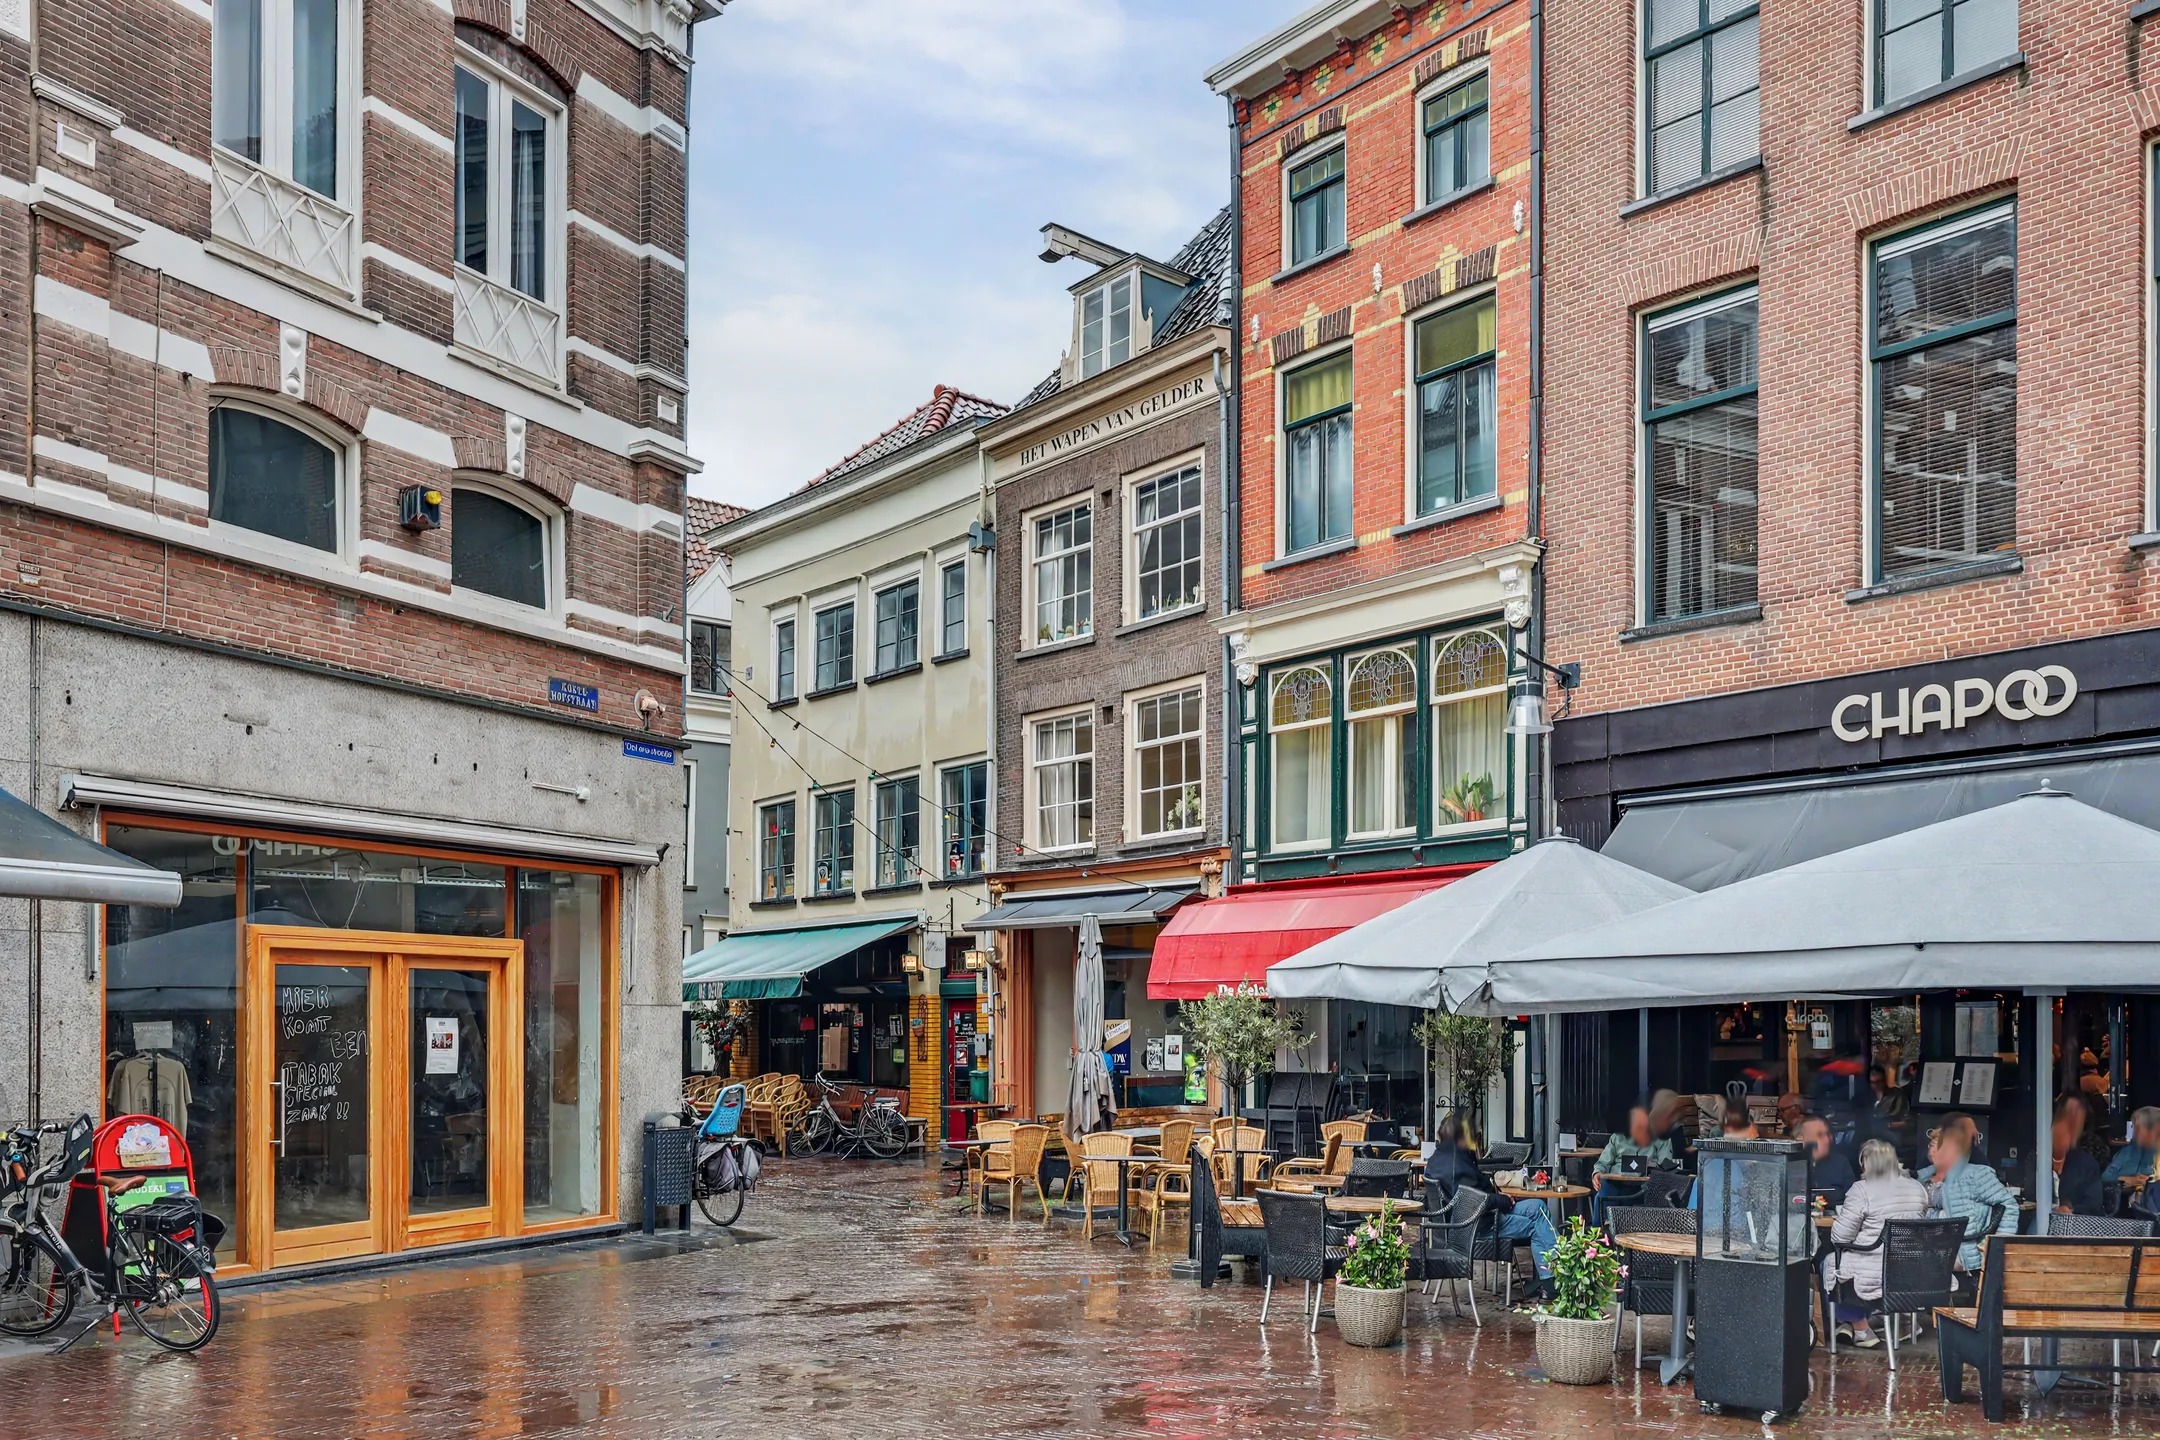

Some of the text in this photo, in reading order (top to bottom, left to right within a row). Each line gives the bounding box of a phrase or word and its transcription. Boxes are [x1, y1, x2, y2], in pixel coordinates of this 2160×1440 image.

[1020, 378, 1204, 466] HET WAPEN VAN GELDER
[549, 690, 596, 710] HOFSTRAAT
[1831, 664, 2078, 742] CHAPOO
[282, 985, 329, 1015] HIER
[1217, 984, 1234, 997] De
[282, 1016, 333, 1039] KOMT
[330, 1029, 369, 1059] EEN
[282, 1062, 343, 1087] TABAK
[286, 1102, 331, 1125] ZAAK
